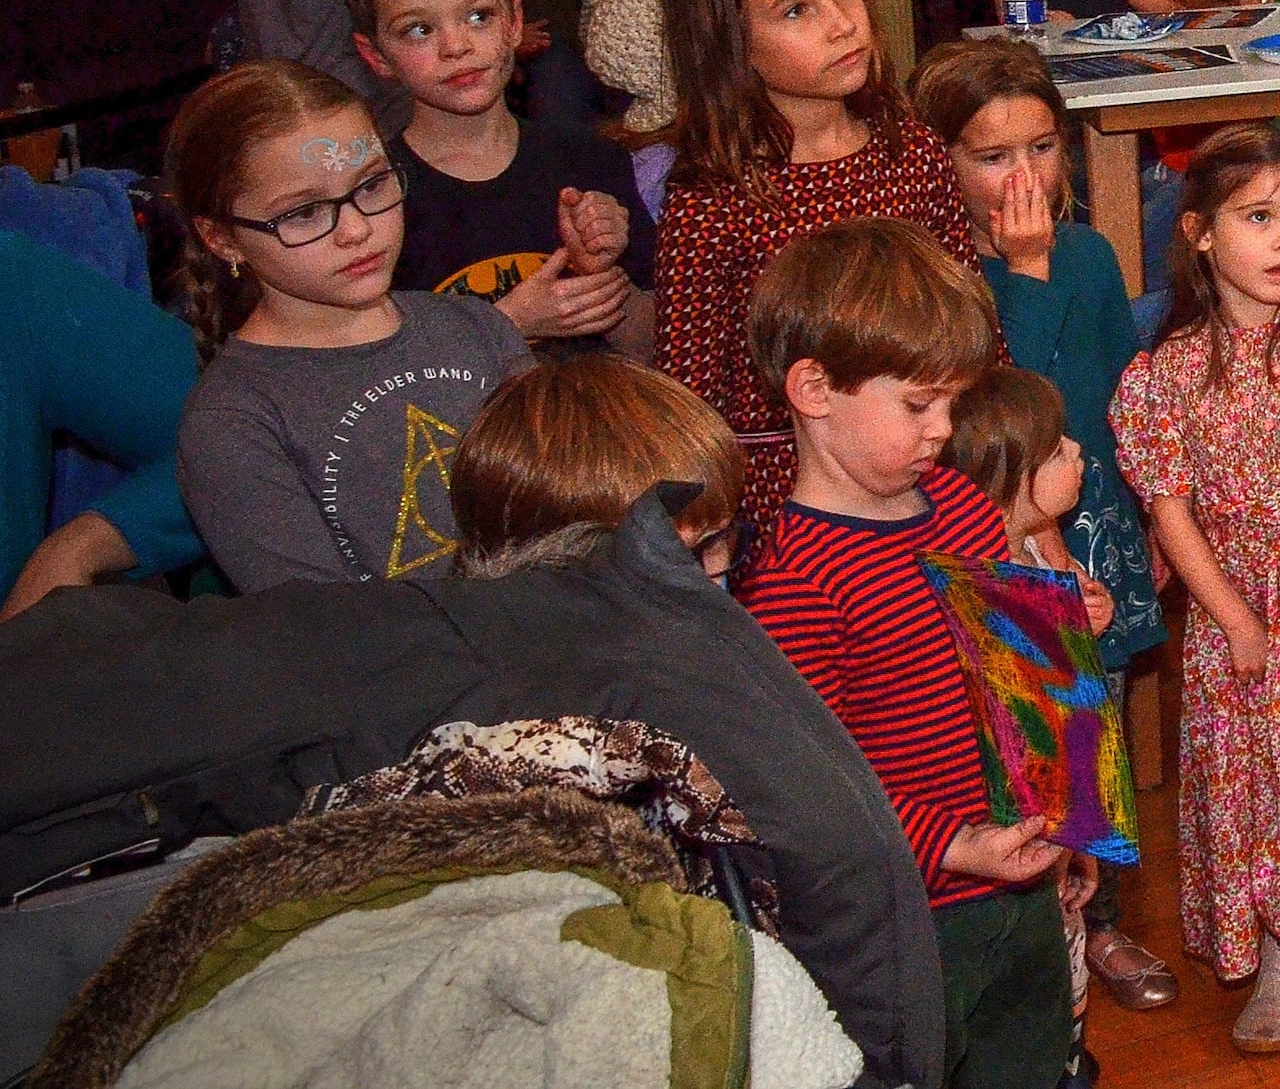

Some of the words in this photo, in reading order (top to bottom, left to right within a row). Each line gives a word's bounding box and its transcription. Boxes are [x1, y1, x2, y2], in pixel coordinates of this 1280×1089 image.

[364, 371, 417, 403] ELDER
[423, 367, 472, 382] WAND
[340, 400, 367, 427] THE
[322, 451, 360, 565] INVISIBILITY
